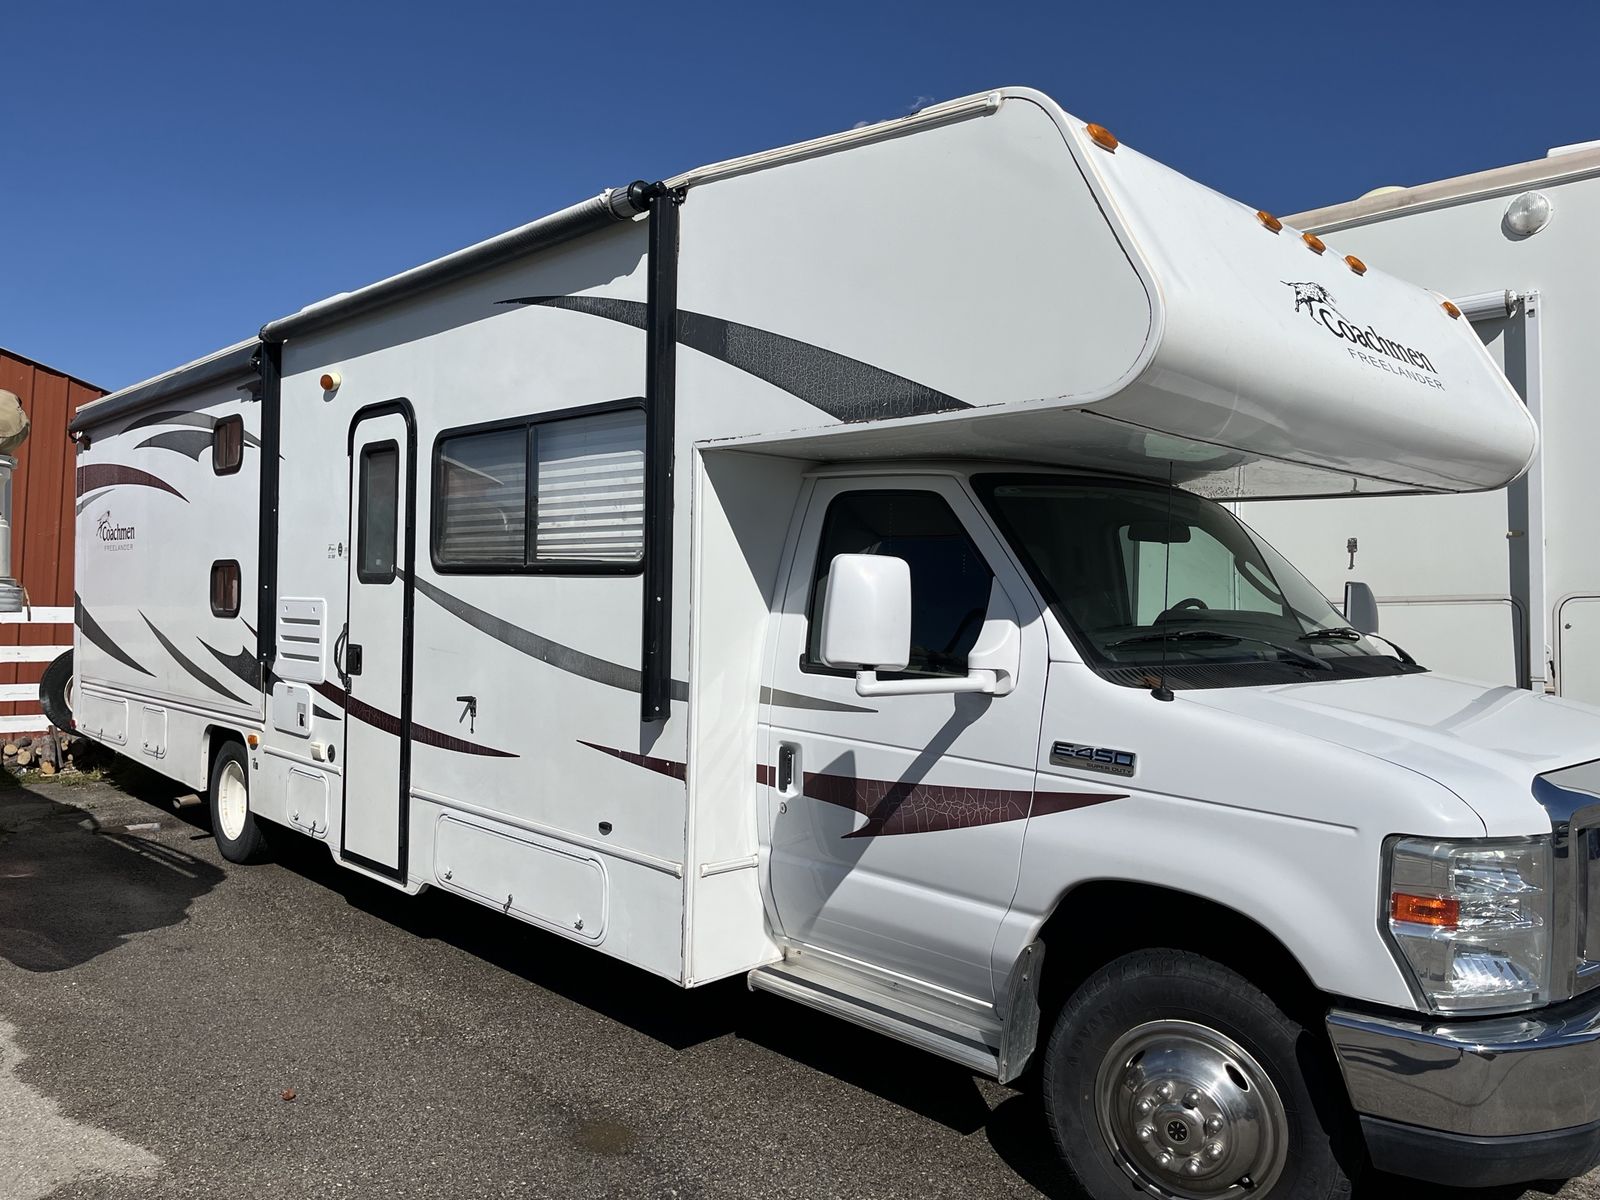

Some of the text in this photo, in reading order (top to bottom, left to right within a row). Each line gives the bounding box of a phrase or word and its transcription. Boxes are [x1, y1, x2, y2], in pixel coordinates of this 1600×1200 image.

[1319, 308, 1438, 374] Coachmen
[1347, 347, 1446, 391] FREELANDER
[102, 523, 135, 541] Coachmen
